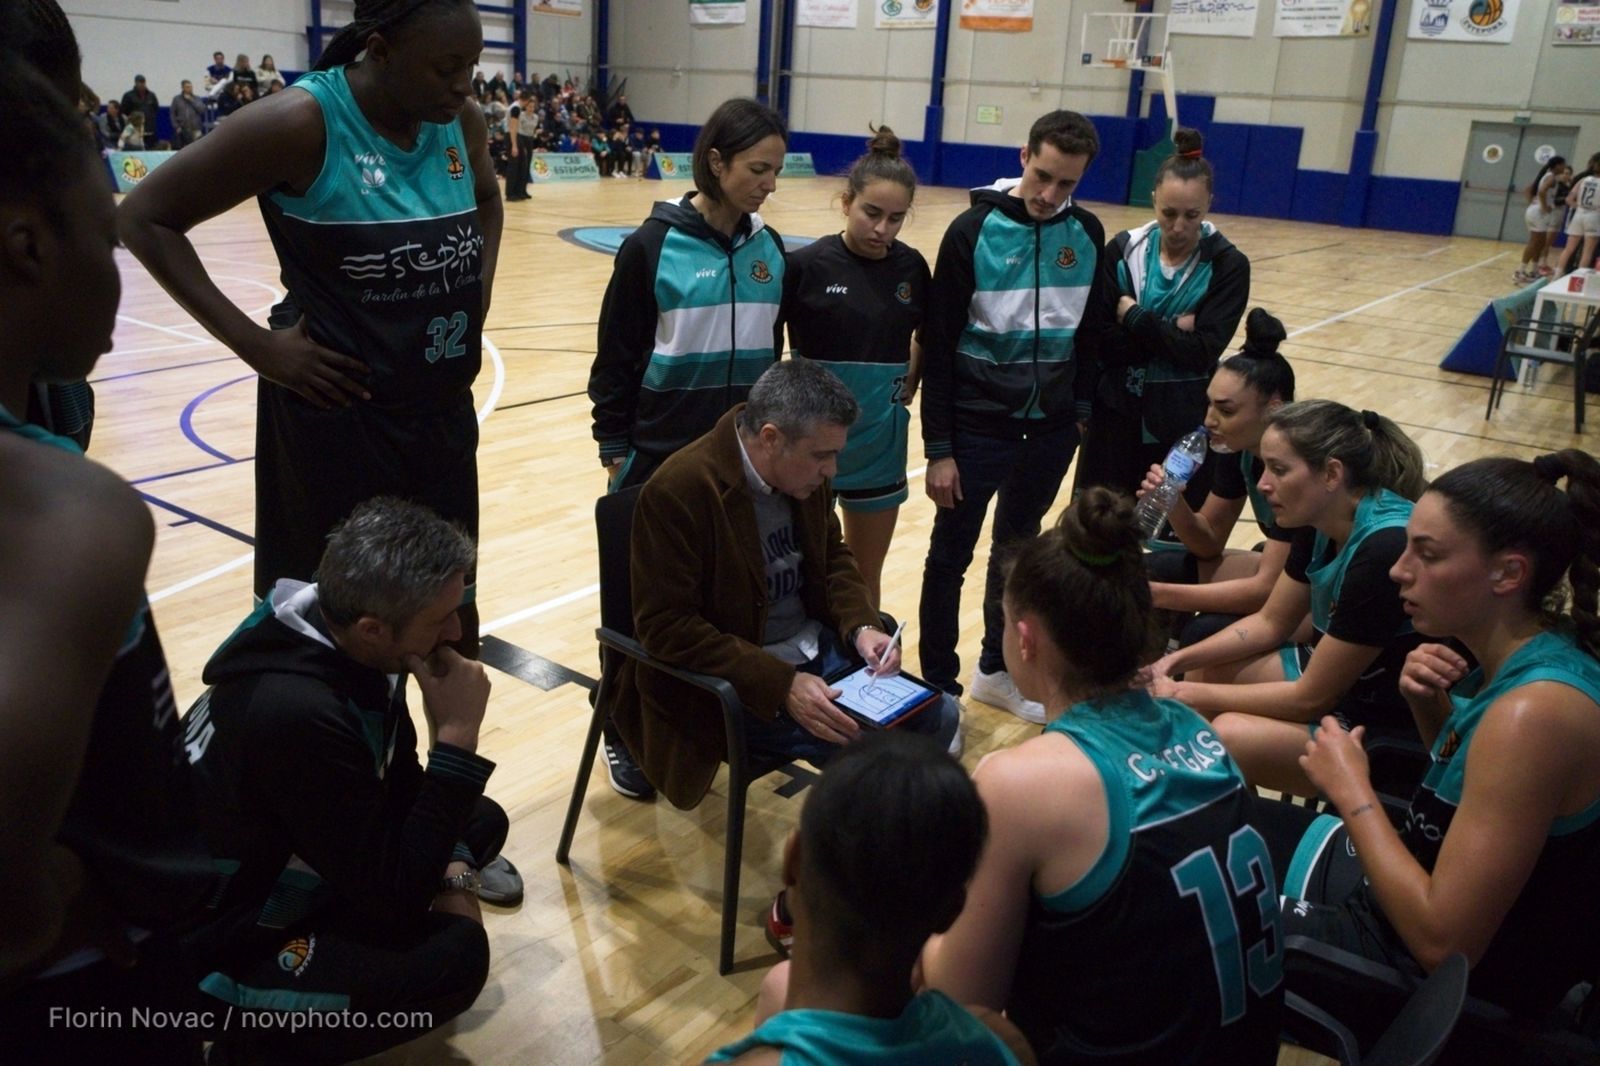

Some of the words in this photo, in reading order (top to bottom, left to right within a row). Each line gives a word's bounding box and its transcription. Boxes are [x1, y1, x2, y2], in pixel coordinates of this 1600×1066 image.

[553, 165, 597, 175] ESTEPONA
[424, 311, 468, 364] 32
[889, 375, 908, 406] 2
[1170, 824, 1285, 1027] 13
